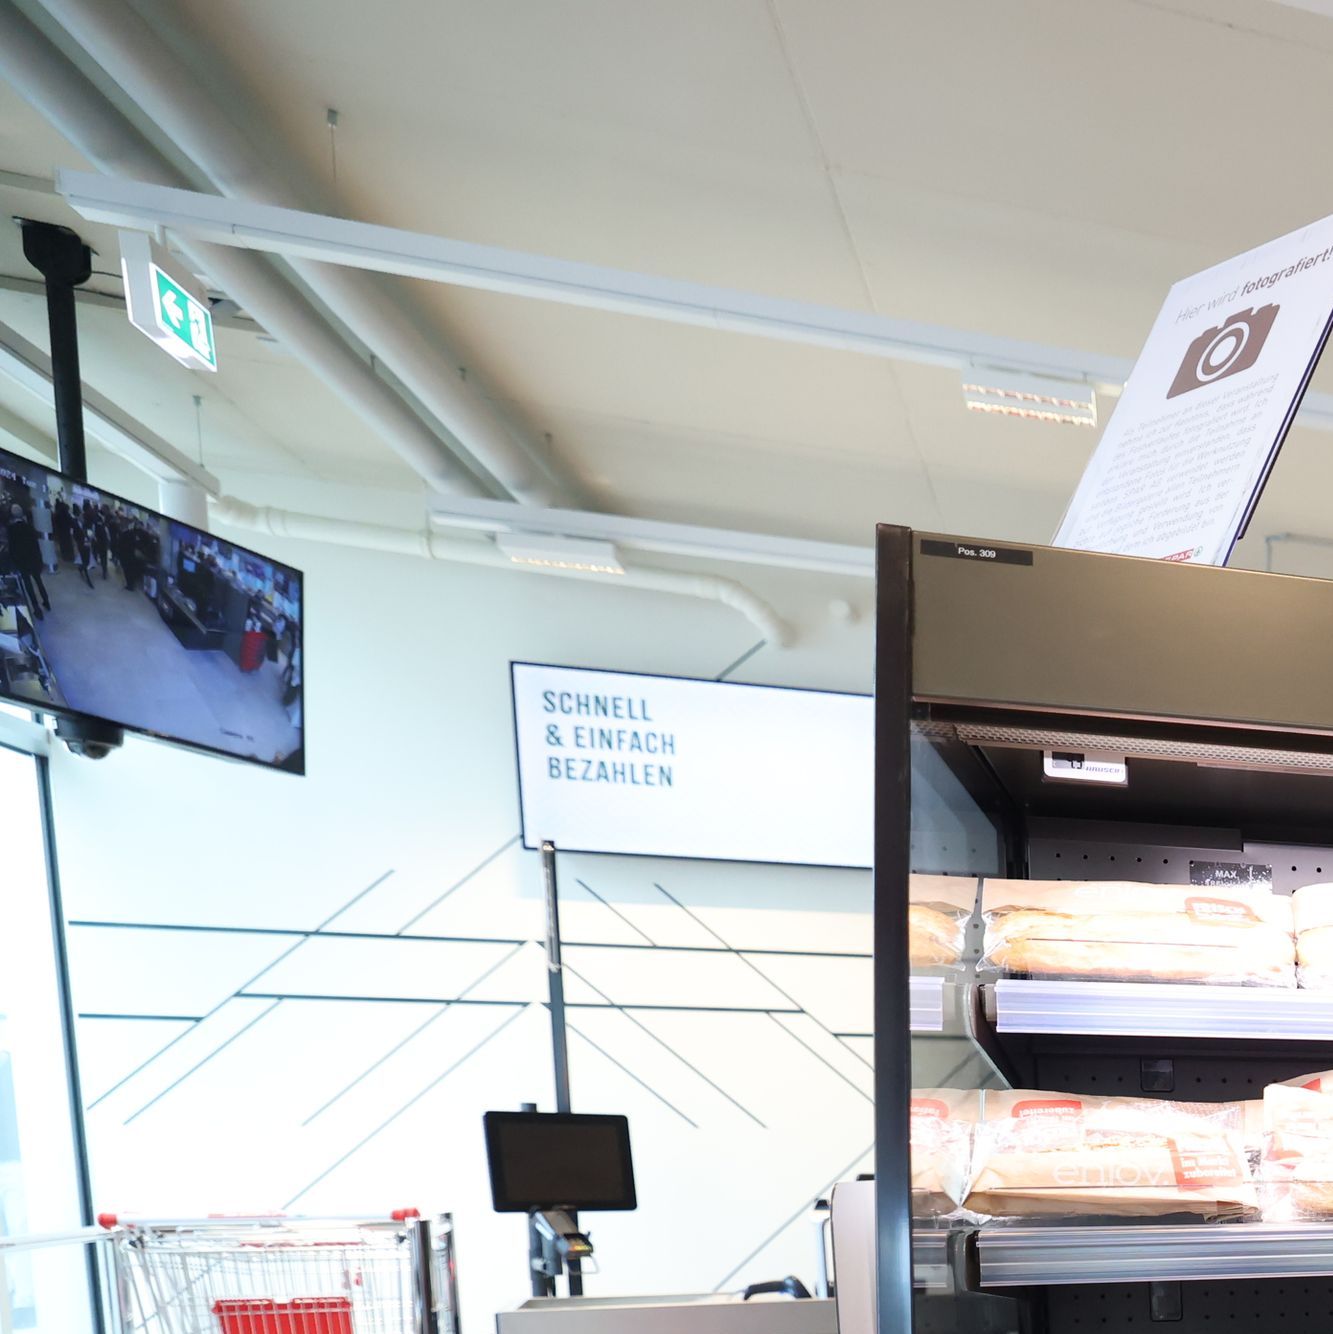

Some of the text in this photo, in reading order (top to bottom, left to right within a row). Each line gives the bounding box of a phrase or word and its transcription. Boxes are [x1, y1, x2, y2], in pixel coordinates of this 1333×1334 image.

[1175, 303, 1205, 324] Hier
[1207, 286, 1241, 310] wird
[958, 546, 997, 559] Pos. 309
[543, 690, 653, 721] SCHNELL
[546, 724, 675, 754] & EINFACH
[549, 757, 672, 786] BEZAHLEN
